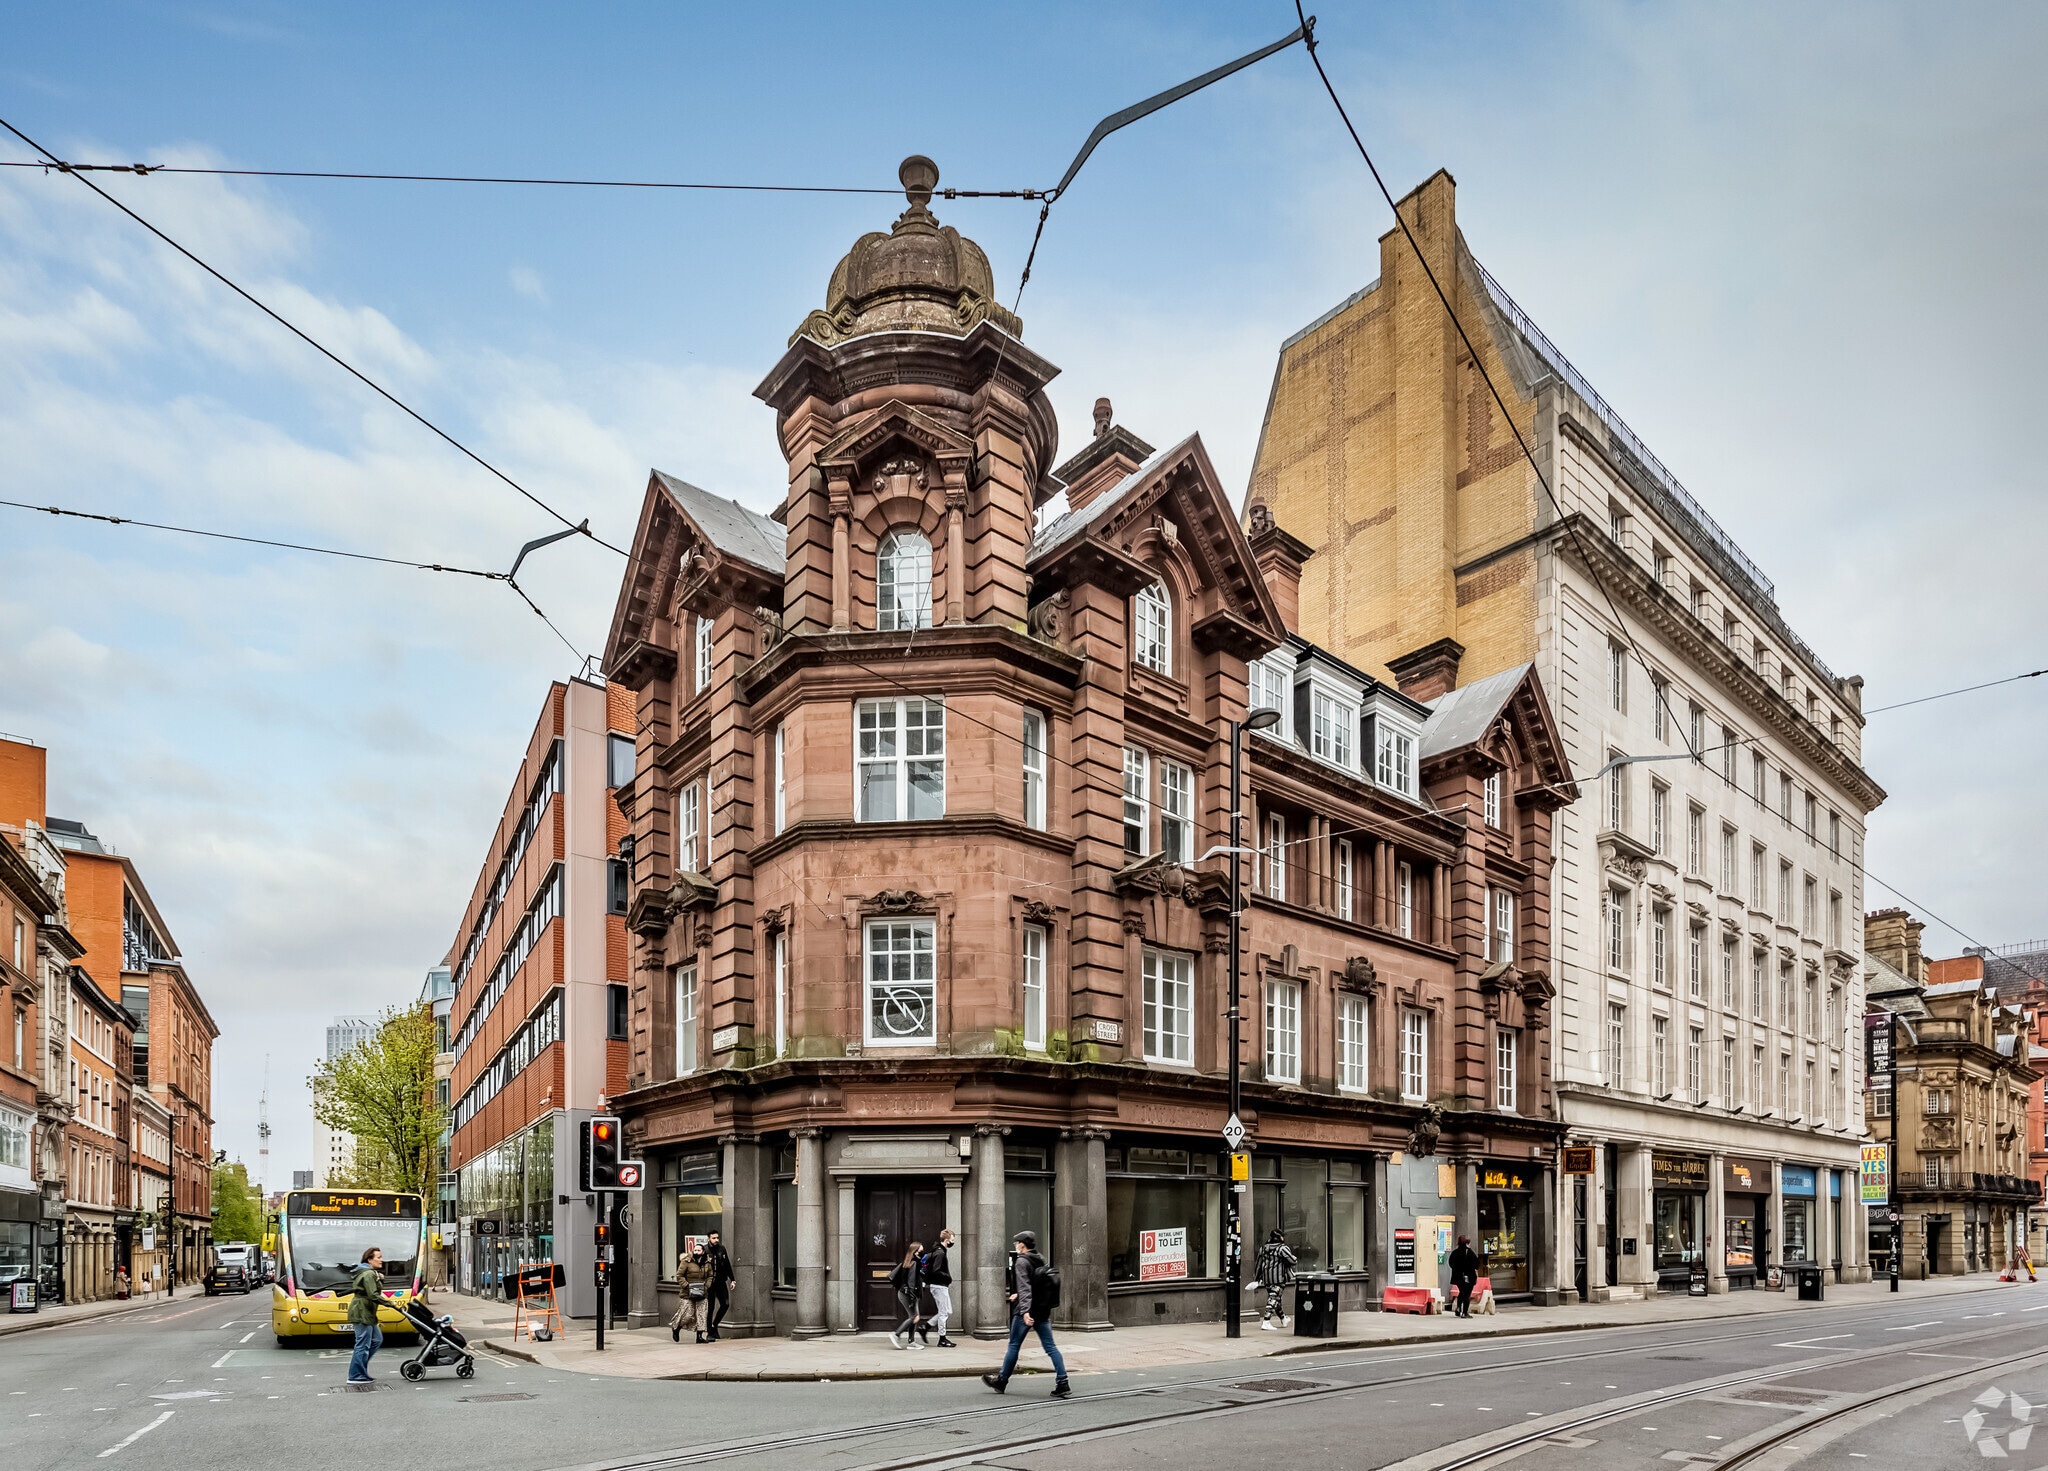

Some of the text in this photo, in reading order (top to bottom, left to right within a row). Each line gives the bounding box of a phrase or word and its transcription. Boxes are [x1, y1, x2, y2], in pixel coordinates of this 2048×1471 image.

[1098, 1023, 1117, 1032] CROSS
[1097, 1031, 1117, 1039] STREET
[1873, 1043, 1888, 1051] NEW
[1225, 1126, 1242, 1136] 20
[1863, 1147, 1885, 1160] YES
[1653, 1160, 1673, 1173] TIMES
[1682, 1161, 1706, 1175] BARBER
[1863, 1161, 1885, 1172] YES
[1741, 1175, 1752, 1188] Shop
[1862, 1173, 1885, 1185] YES
[329, 1196, 401, 1213] Free Bus 1
[296, 1218, 413, 1229] free bus around the city
[1159, 1237, 1183, 1247] TO LET
[1142, 1261, 1185, 1275] 0161 631 2852
